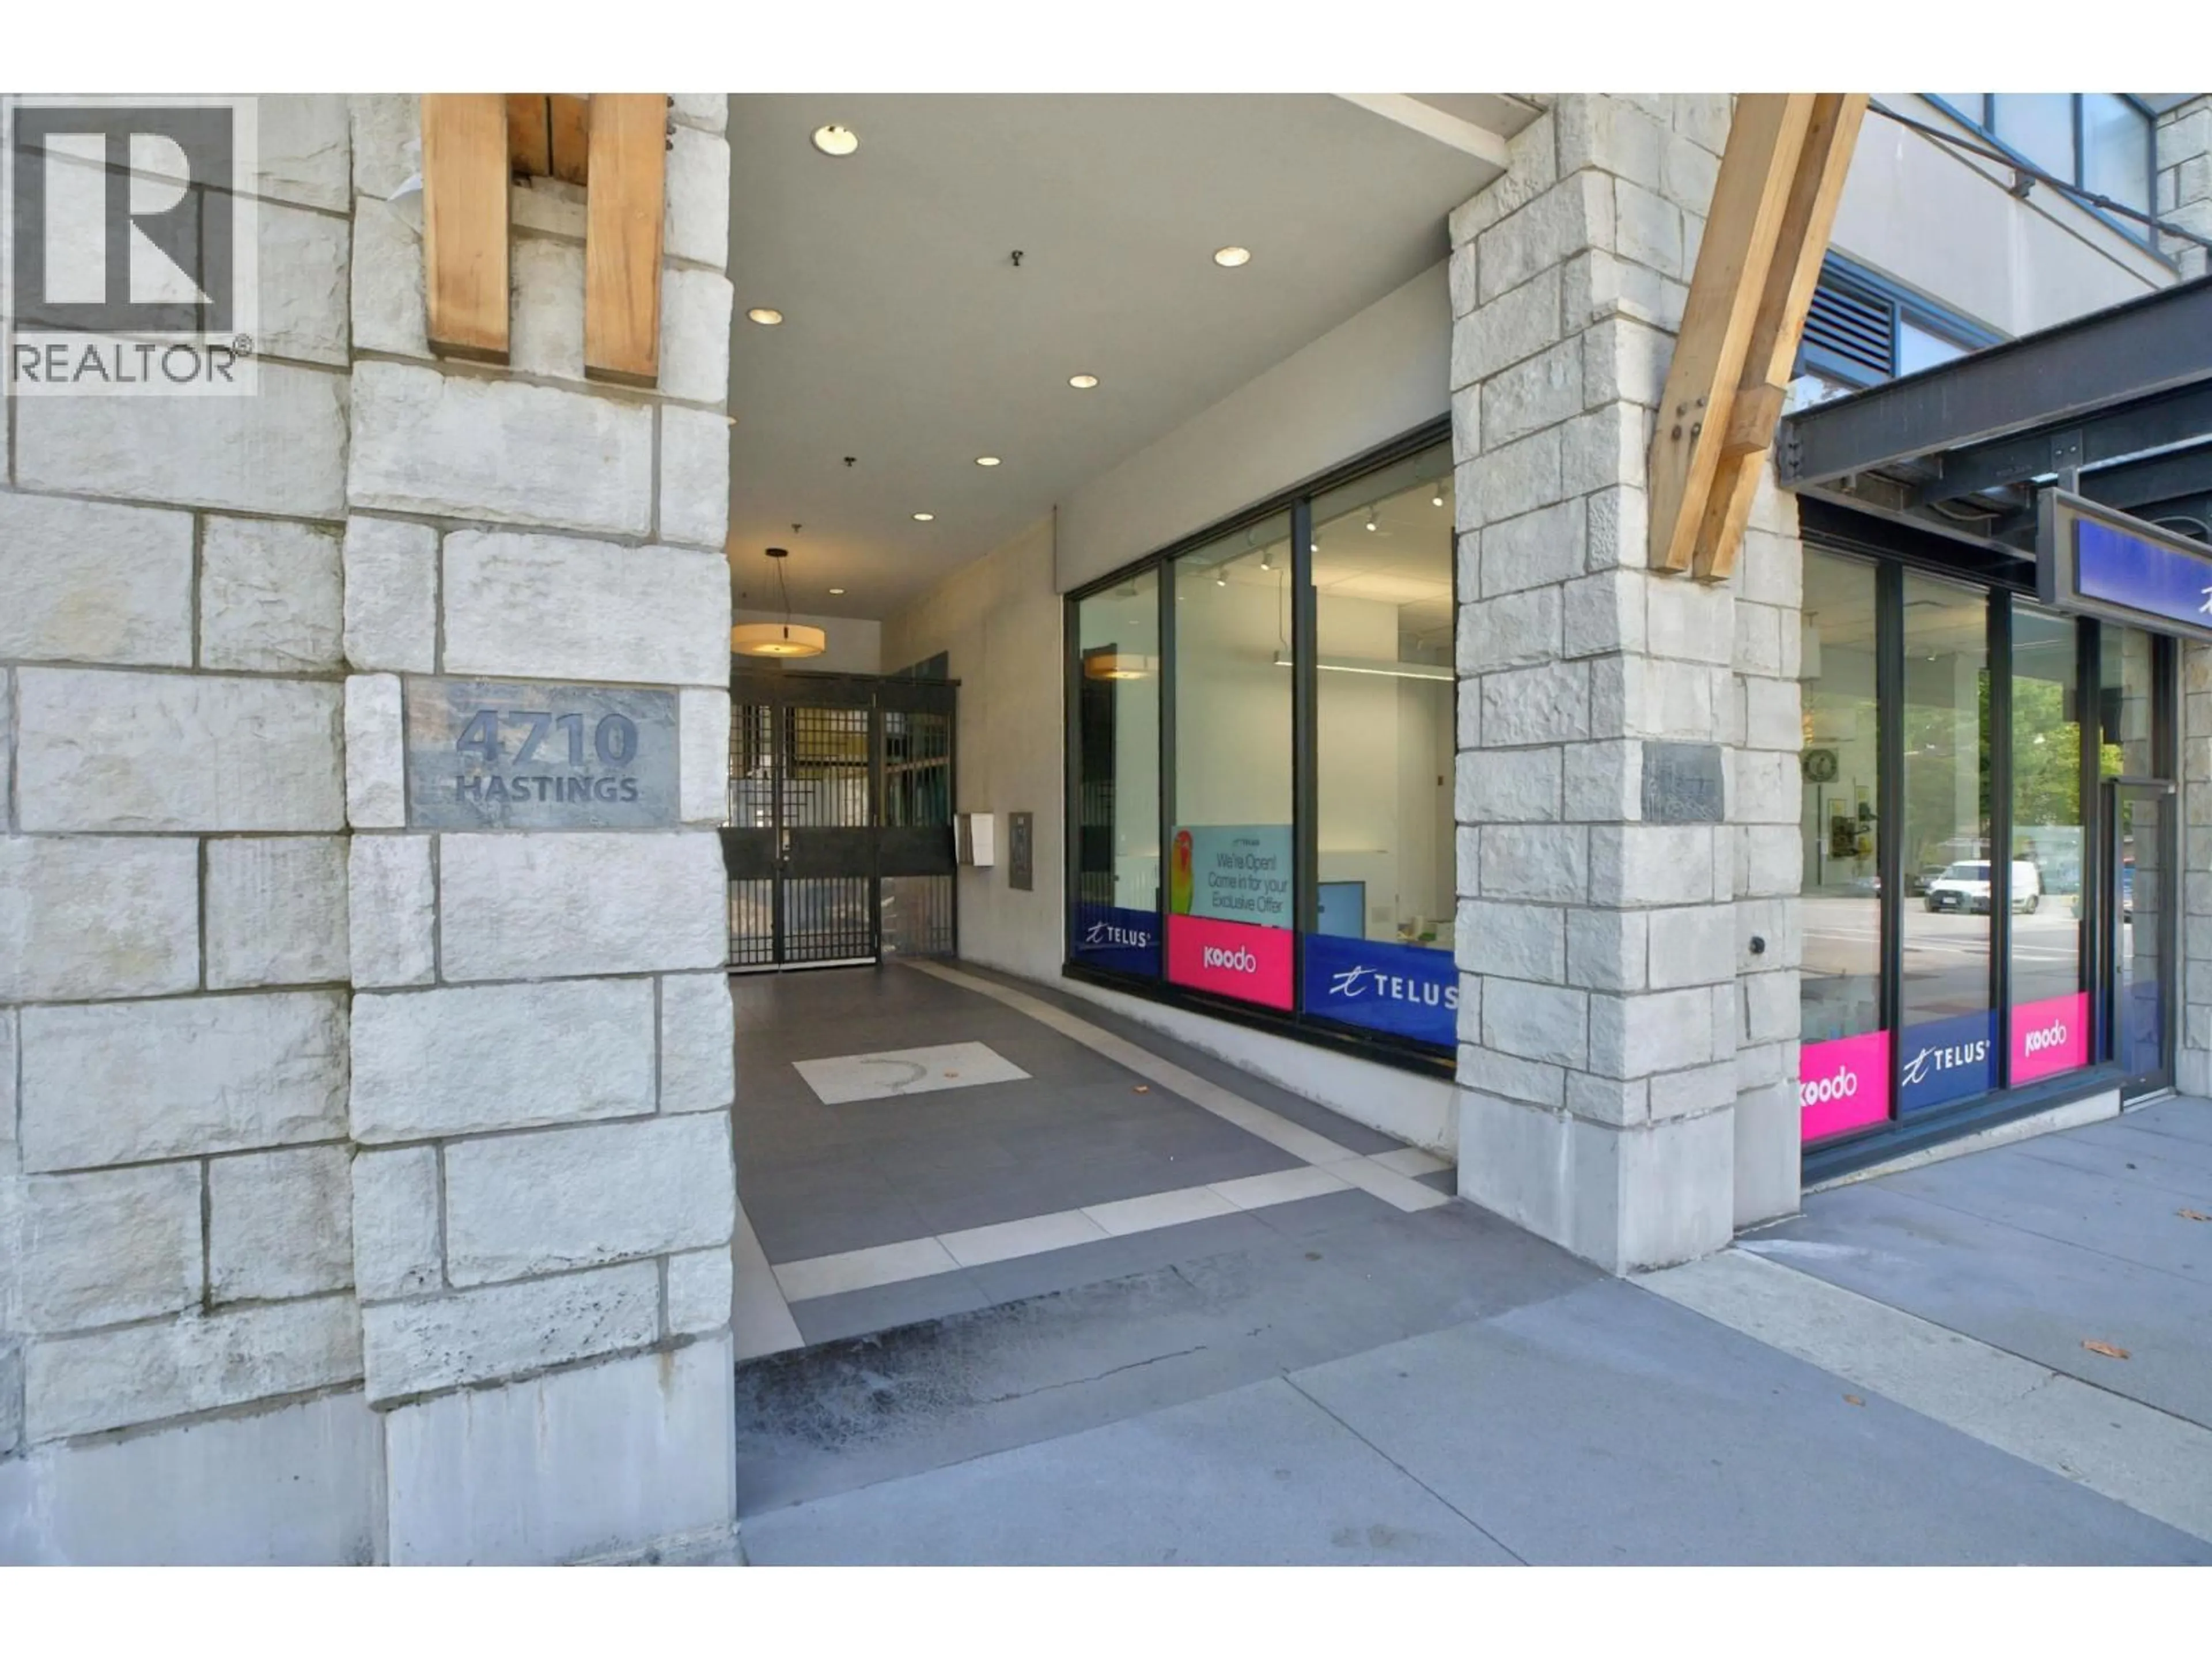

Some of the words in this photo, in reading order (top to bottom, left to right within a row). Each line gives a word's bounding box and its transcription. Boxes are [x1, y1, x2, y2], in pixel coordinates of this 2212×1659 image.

[456, 709, 639, 768] 4710
[456, 775, 639, 803] HASTINGS
[1209, 872, 1237, 889] Come
[1238, 874, 1247, 889] in
[1248, 874, 1262, 891] for
[1264, 878, 1287, 895] your
[1212, 891, 1255, 911] Exclusive
[1256, 895, 1283, 914] Offer
[1203, 945, 1256, 973] koodo
[1374, 974, 1459, 1010] TELUS
[2025, 1018, 2067, 1058] koodo
